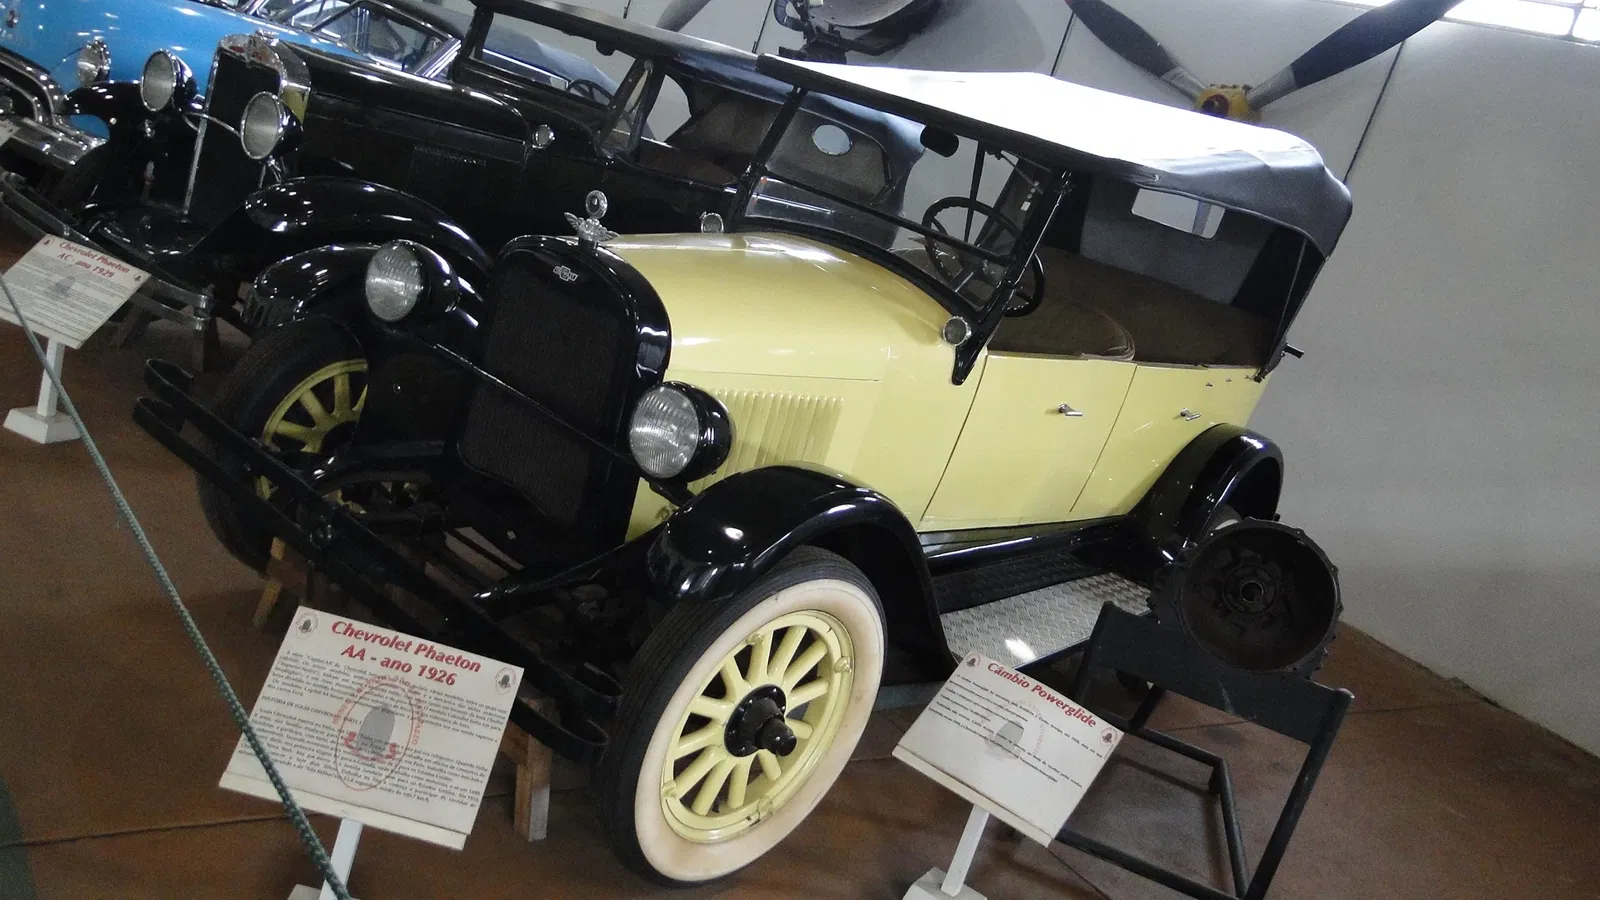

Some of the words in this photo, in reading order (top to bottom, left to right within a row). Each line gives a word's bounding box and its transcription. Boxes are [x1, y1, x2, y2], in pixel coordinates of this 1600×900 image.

[60, 241, 97, 259] Chevrolet
[97, 255, 130, 273] Phaeton
[93, 266, 115, 278] 1929
[332, 621, 412, 652] Chevrolet
[414, 642, 482, 672] Phaeton
[341, 645, 366, 661] AA
[380, 657, 412, 673] ano
[418, 665, 458, 686] 1926
[987, 663, 1030, 688] Câmbio
[1031, 684, 1096, 727] Powerglide
